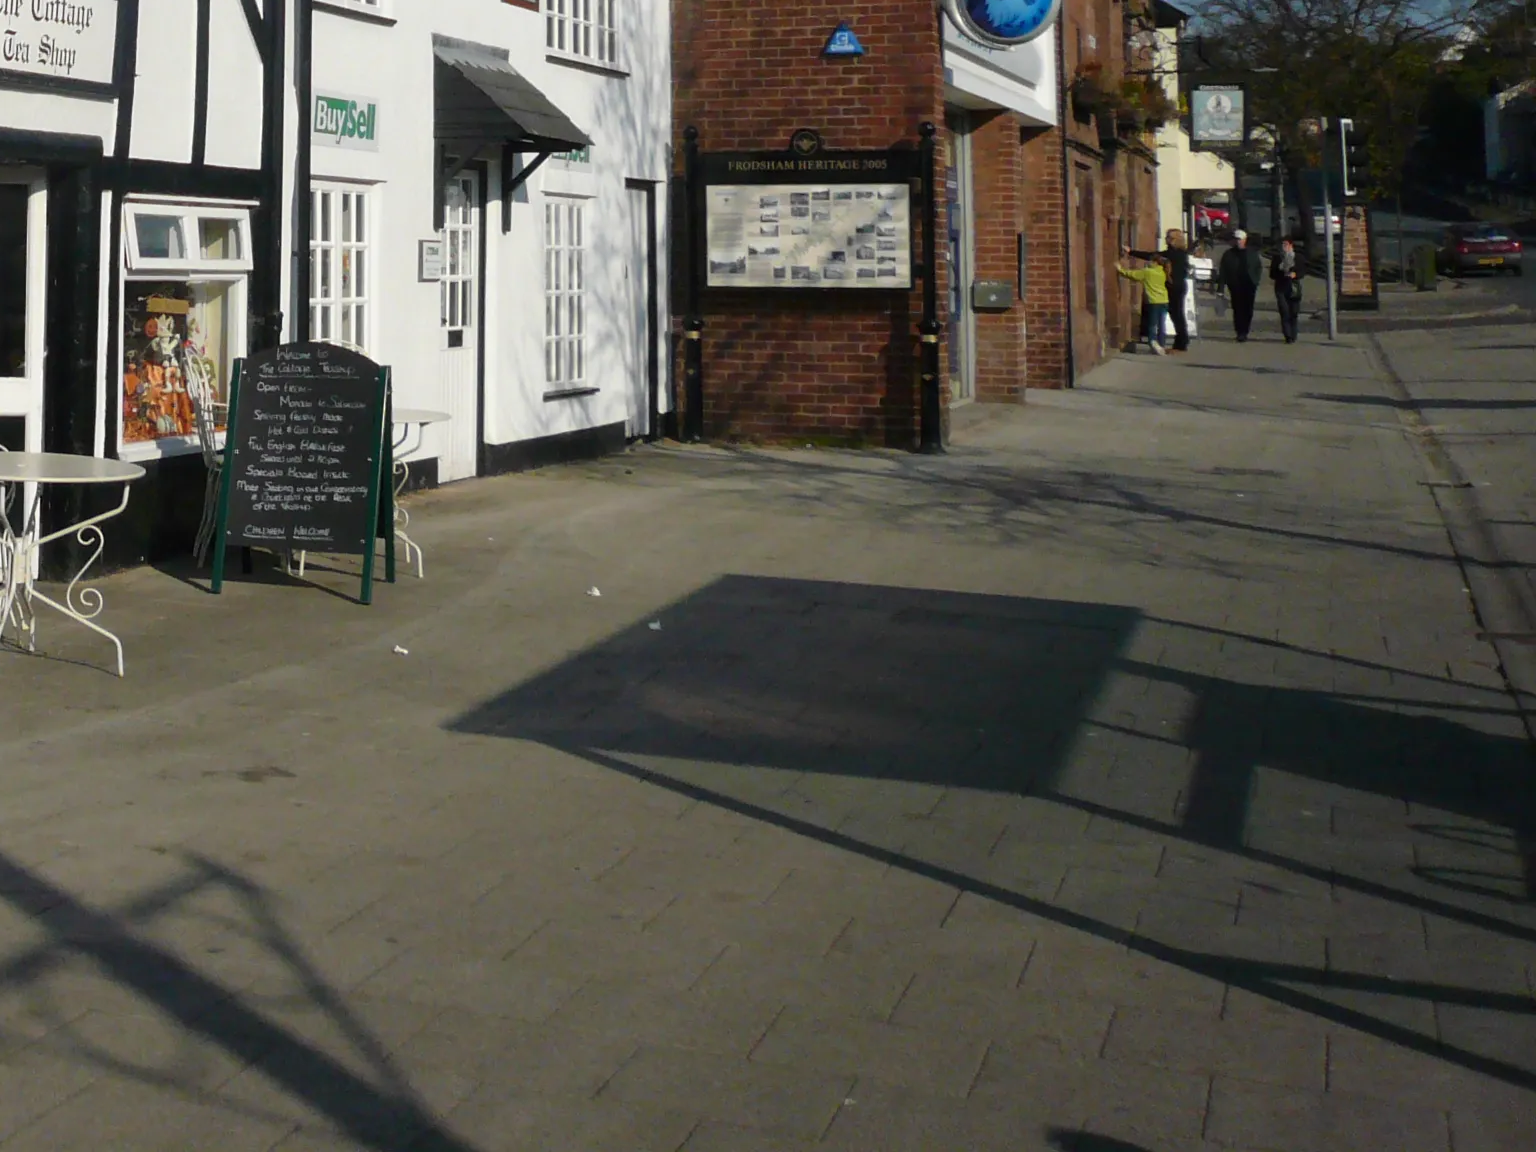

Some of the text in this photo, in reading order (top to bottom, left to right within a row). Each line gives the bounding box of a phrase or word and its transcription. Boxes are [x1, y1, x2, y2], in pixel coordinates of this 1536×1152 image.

[3, 29, 76, 75] Tea Shop
[728, 160, 795, 171] FRODSHAM
[798, 160, 860, 170] HERITAGE
[256, 381, 280, 393] Open
